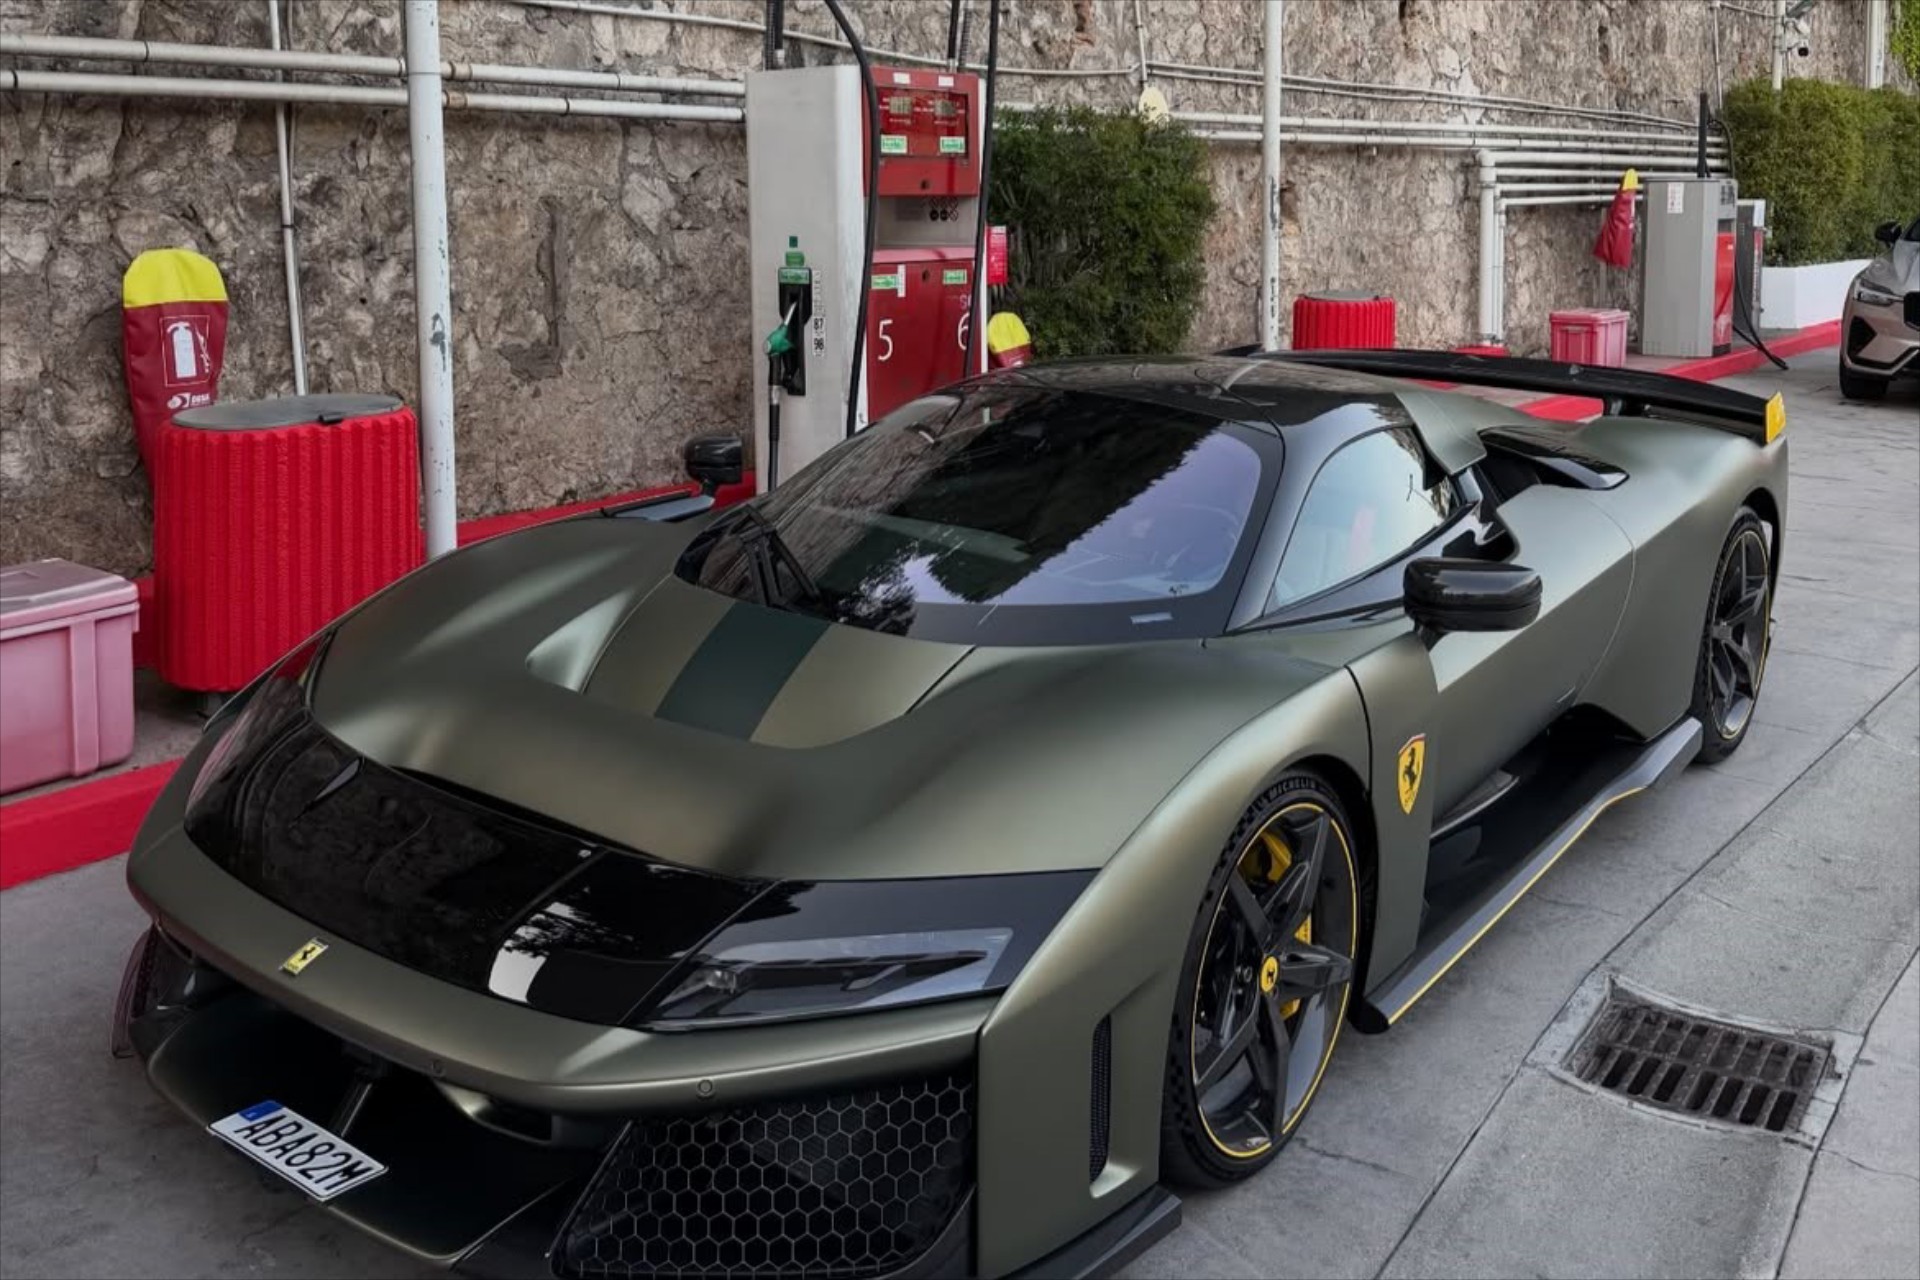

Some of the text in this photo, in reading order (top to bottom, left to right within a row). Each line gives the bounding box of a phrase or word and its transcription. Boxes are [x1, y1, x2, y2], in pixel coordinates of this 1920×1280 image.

[878, 319, 894, 361] 5
[1269, 778, 1316, 800] MICHELIN
[233, 1113, 373, 1191] ABA82M
